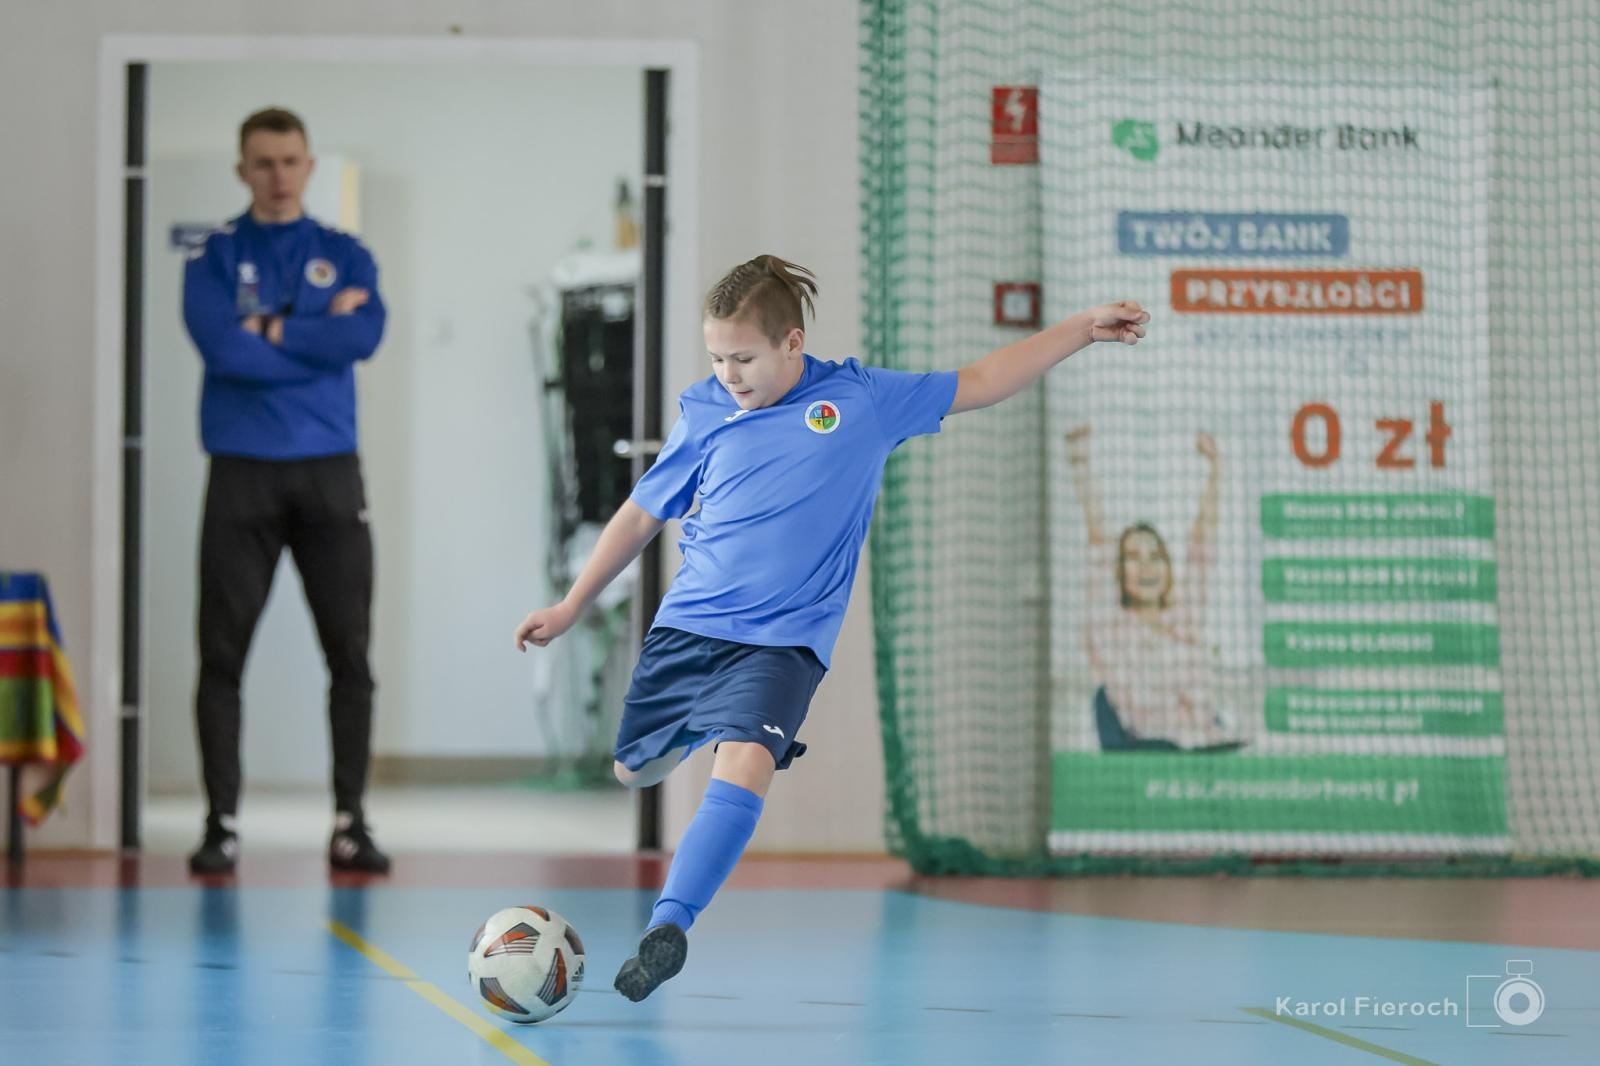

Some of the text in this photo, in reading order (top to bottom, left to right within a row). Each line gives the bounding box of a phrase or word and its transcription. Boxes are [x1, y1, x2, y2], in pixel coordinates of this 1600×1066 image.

[1176, 122, 1419, 152] Meander Bank
[1133, 215, 1334, 251] TWÓJ BANK
[1291, 400, 1452, 470] 0 zł
